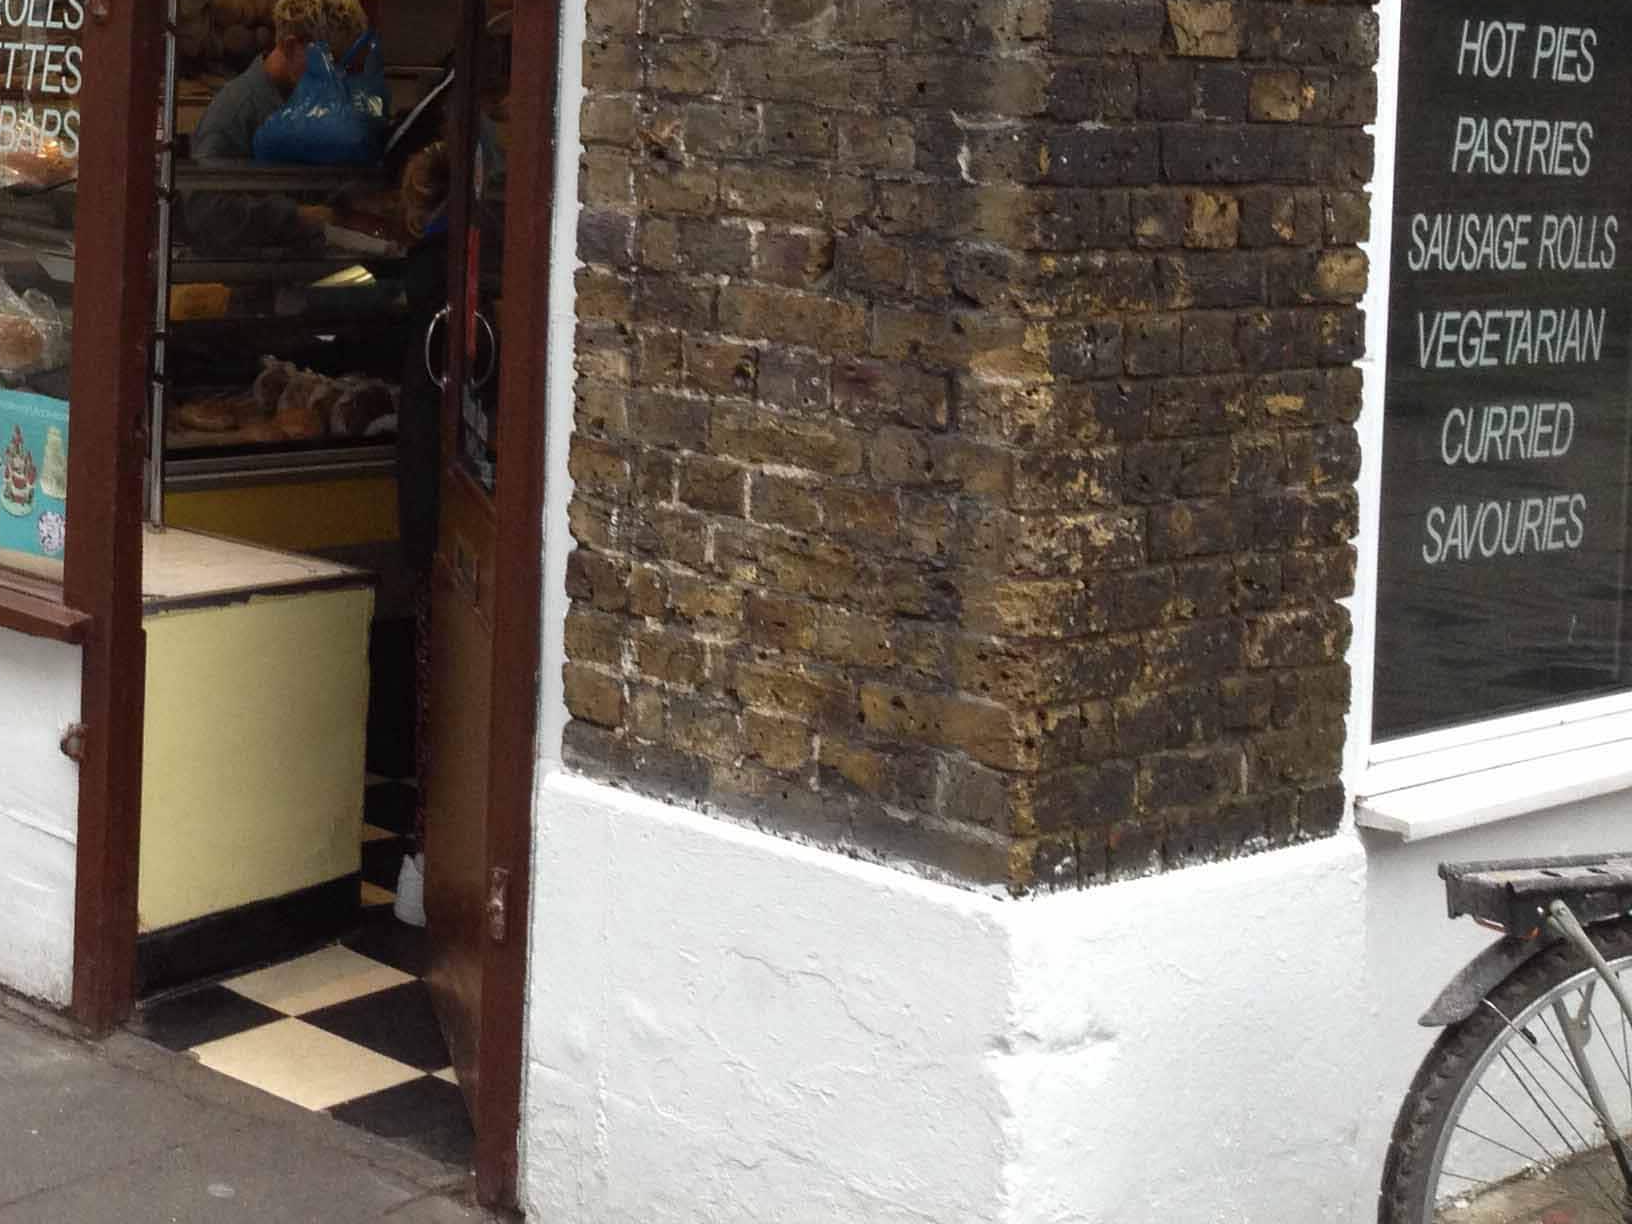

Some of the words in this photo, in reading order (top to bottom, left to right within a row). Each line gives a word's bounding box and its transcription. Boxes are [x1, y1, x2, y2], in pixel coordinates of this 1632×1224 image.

[1457, 19, 1526, 78] HOT
[1532, 24, 1598, 83] PIES
[1450, 116, 1594, 176] PASTRIES
[1407, 213, 1532, 271] SAUSAGE
[1537, 214, 1619, 270] ROLLS
[1418, 307, 1607, 369] VEGETARIAN
[1440, 401, 1576, 465] CURRIED
[1422, 492, 1587, 564] SAVOURIES
